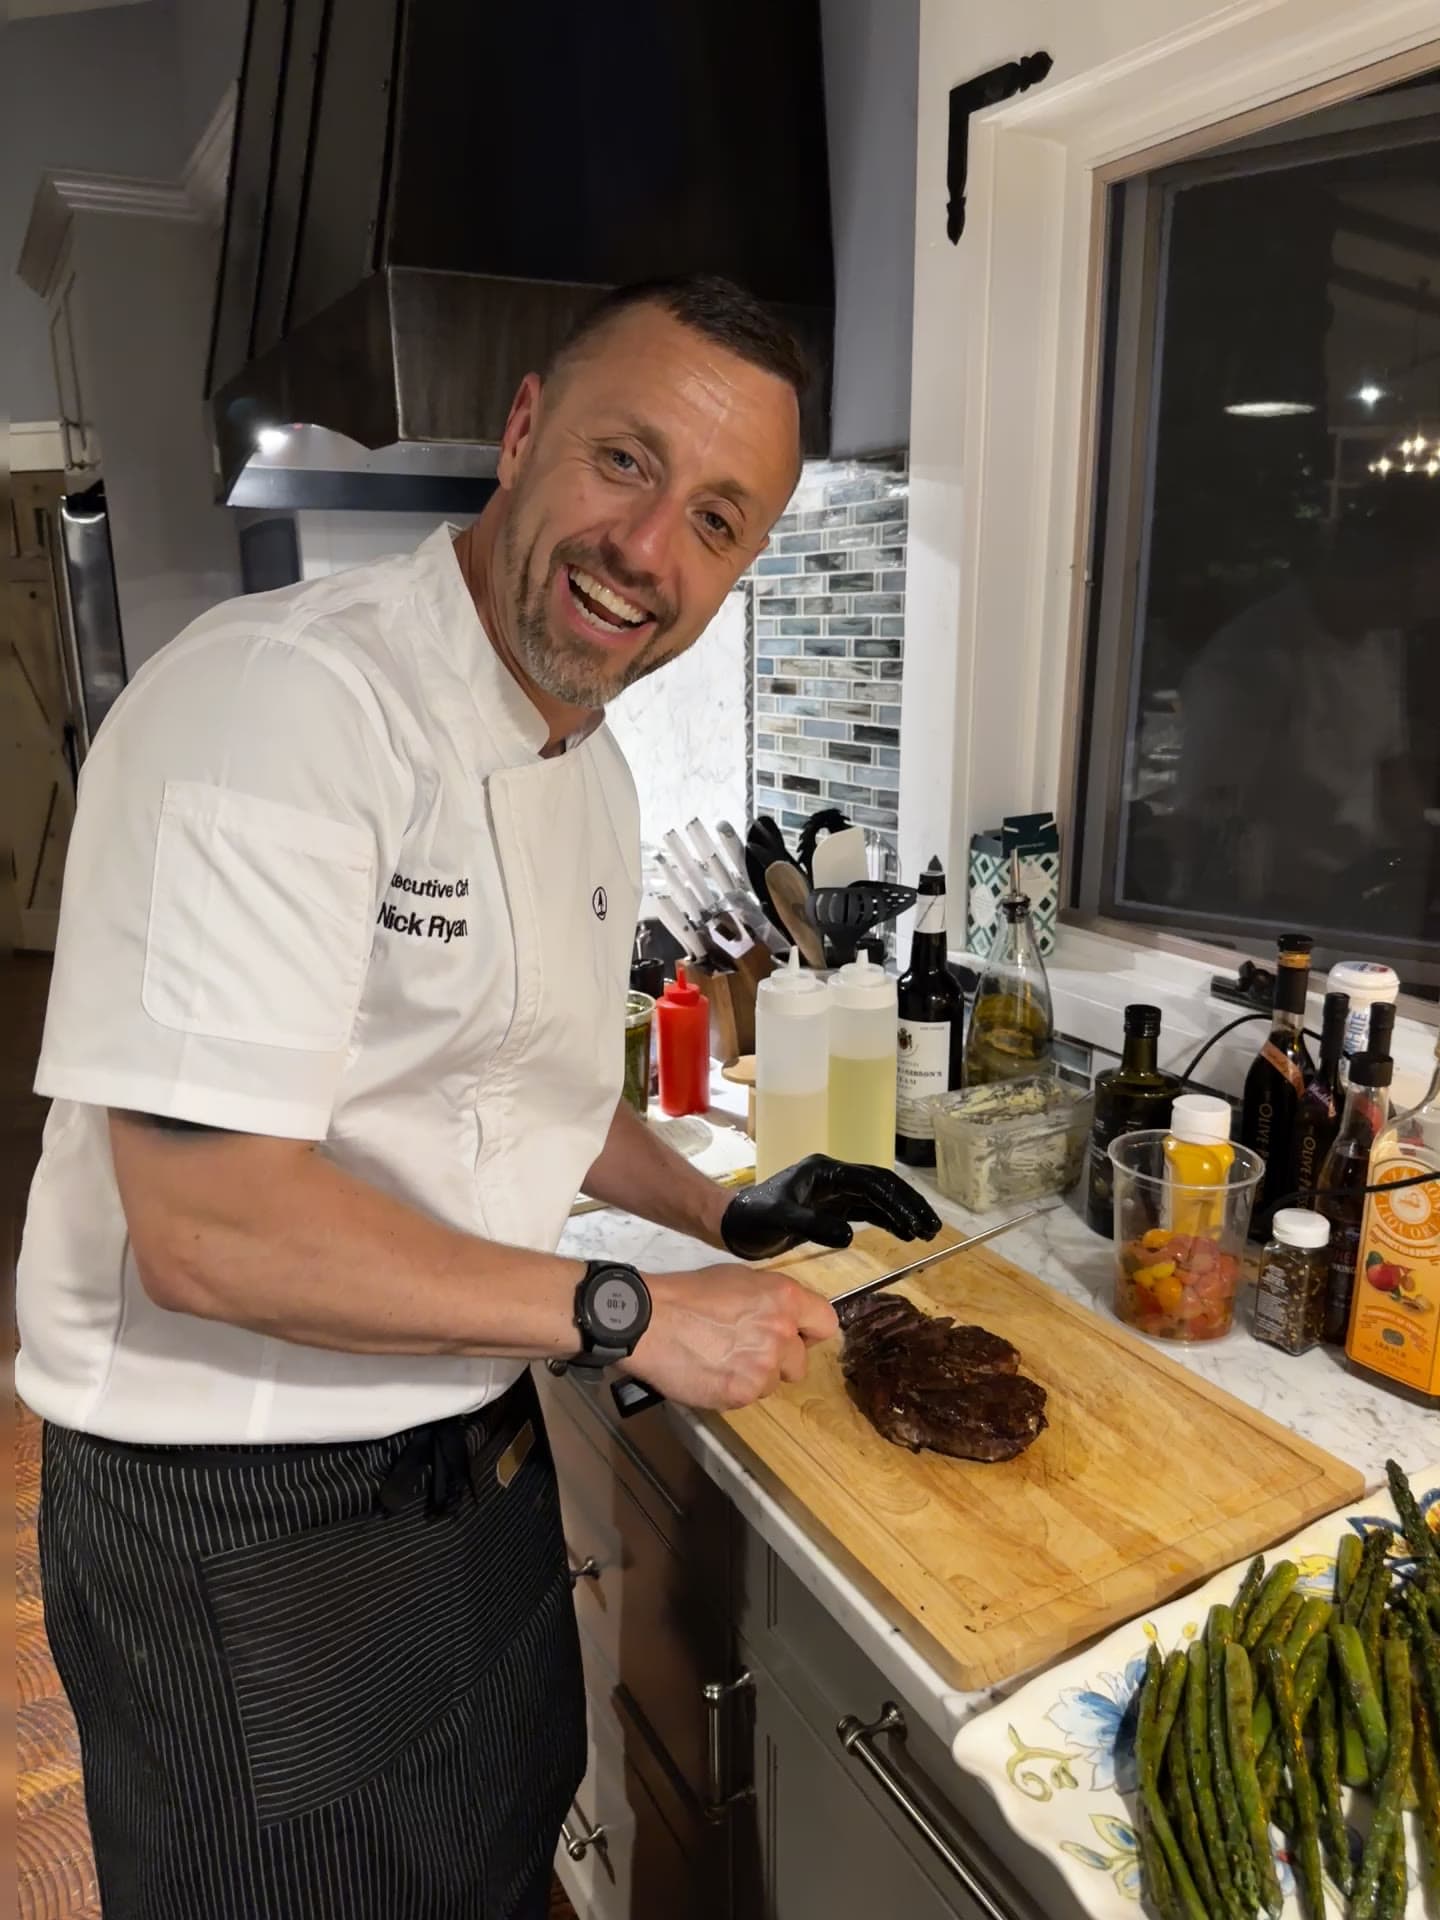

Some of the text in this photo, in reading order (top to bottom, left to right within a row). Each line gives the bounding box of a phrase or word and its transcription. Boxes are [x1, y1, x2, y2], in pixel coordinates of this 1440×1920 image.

[391, 872, 454, 898] ecutive
[376, 901, 468, 943] Nick Ryan
[1256, 1103, 1274, 1145] OLIVE
[1300, 1135, 1317, 1176] OLIVE
